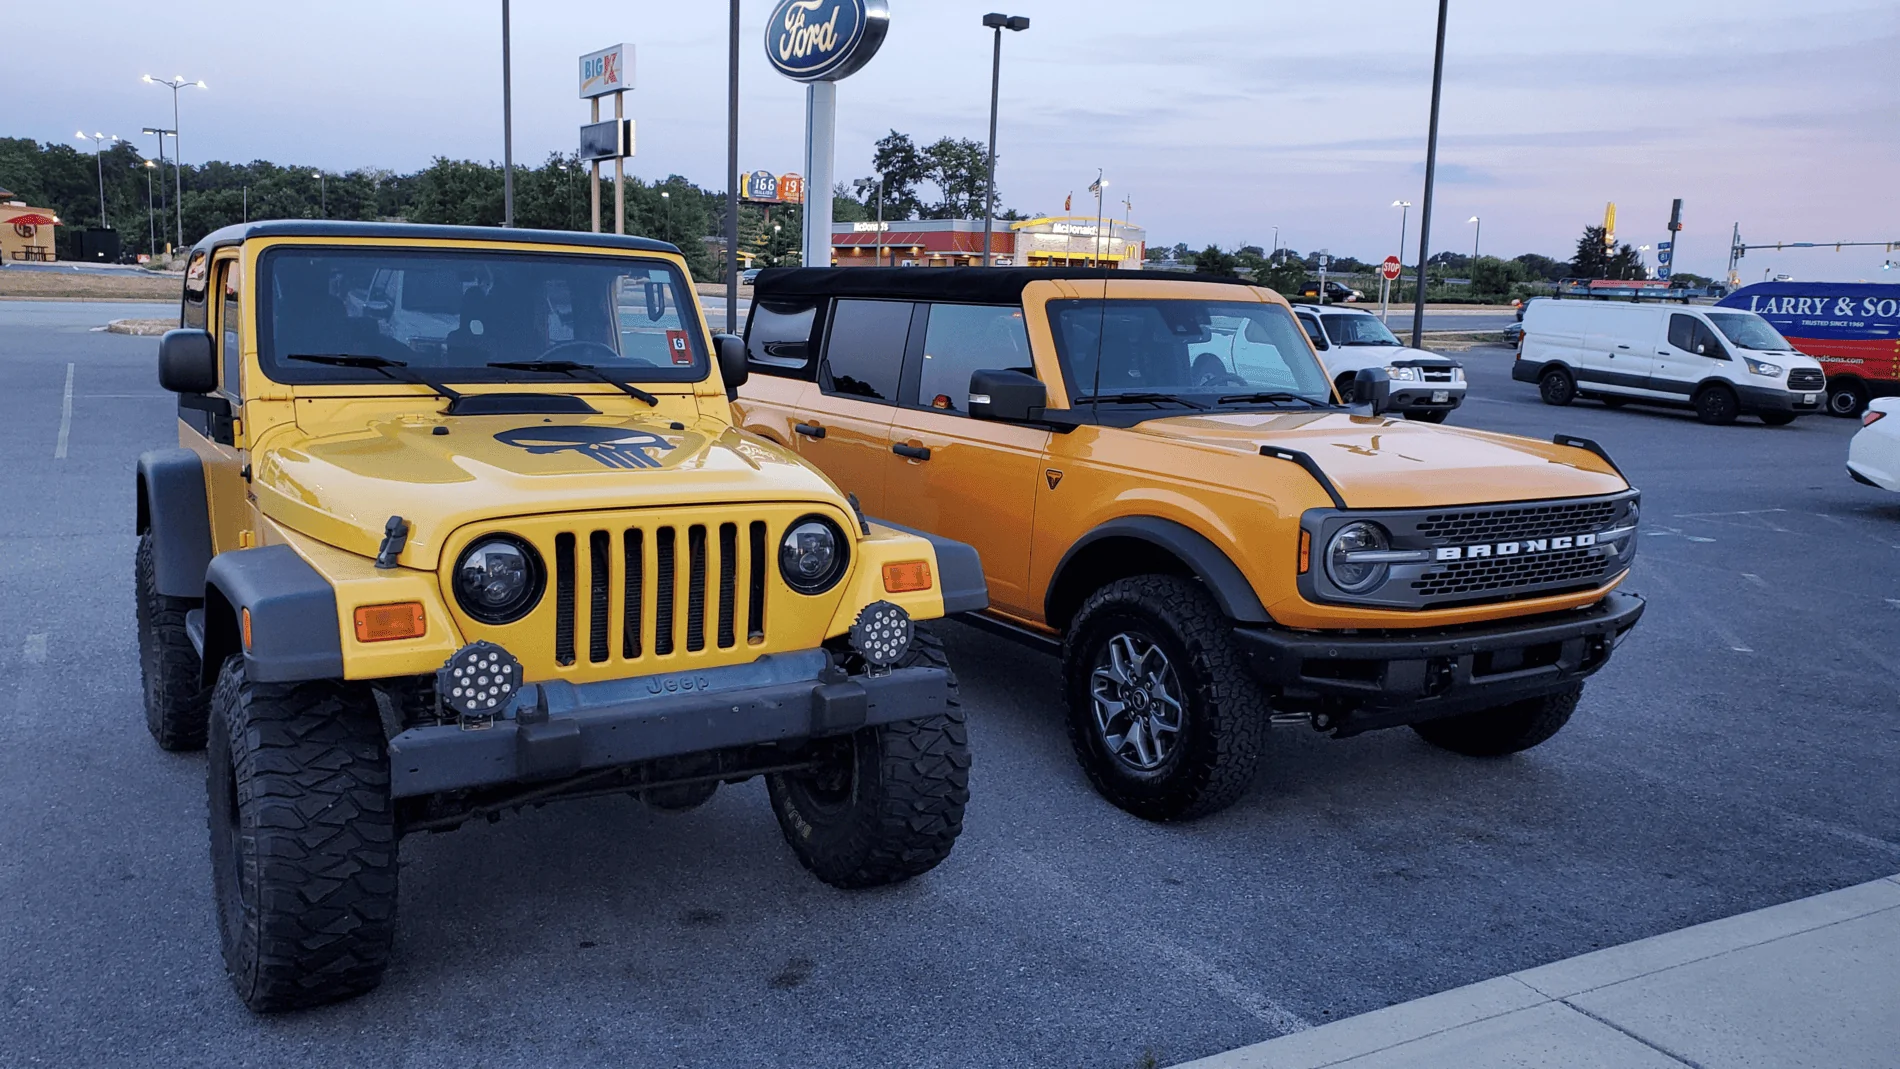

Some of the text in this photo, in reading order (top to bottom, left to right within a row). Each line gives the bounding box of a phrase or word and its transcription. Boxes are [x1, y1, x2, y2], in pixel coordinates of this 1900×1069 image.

[780, 0, 840, 61] Ford
[585, 52, 618, 85] BIG K
[755, 178, 775, 191] 166
[1383, 262, 1400, 272] STOP
[1750, 295, 1830, 315] LARRY
[1834, 296, 1857, 317] &
[675, 338, 683, 348] 6
[1436, 533, 1596, 561] BRONCO
[646, 676, 709, 694] Jeep
